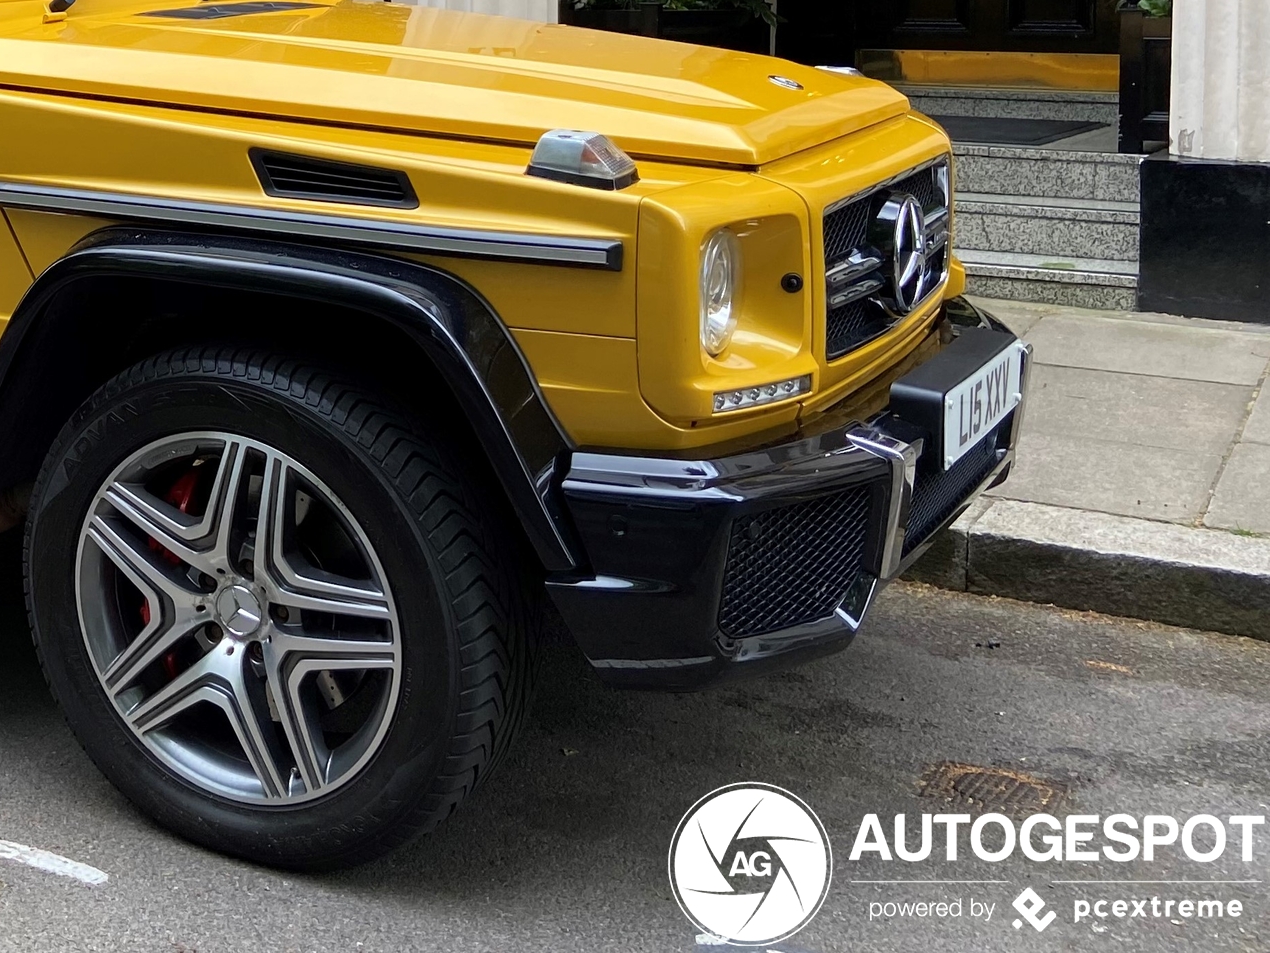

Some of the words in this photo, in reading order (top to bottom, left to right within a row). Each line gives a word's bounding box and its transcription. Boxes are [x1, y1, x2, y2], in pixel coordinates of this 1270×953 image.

[62, 394, 143, 482] ADVAN
[959, 379, 983, 448] L15
[984, 356, 1011, 426] XXV
